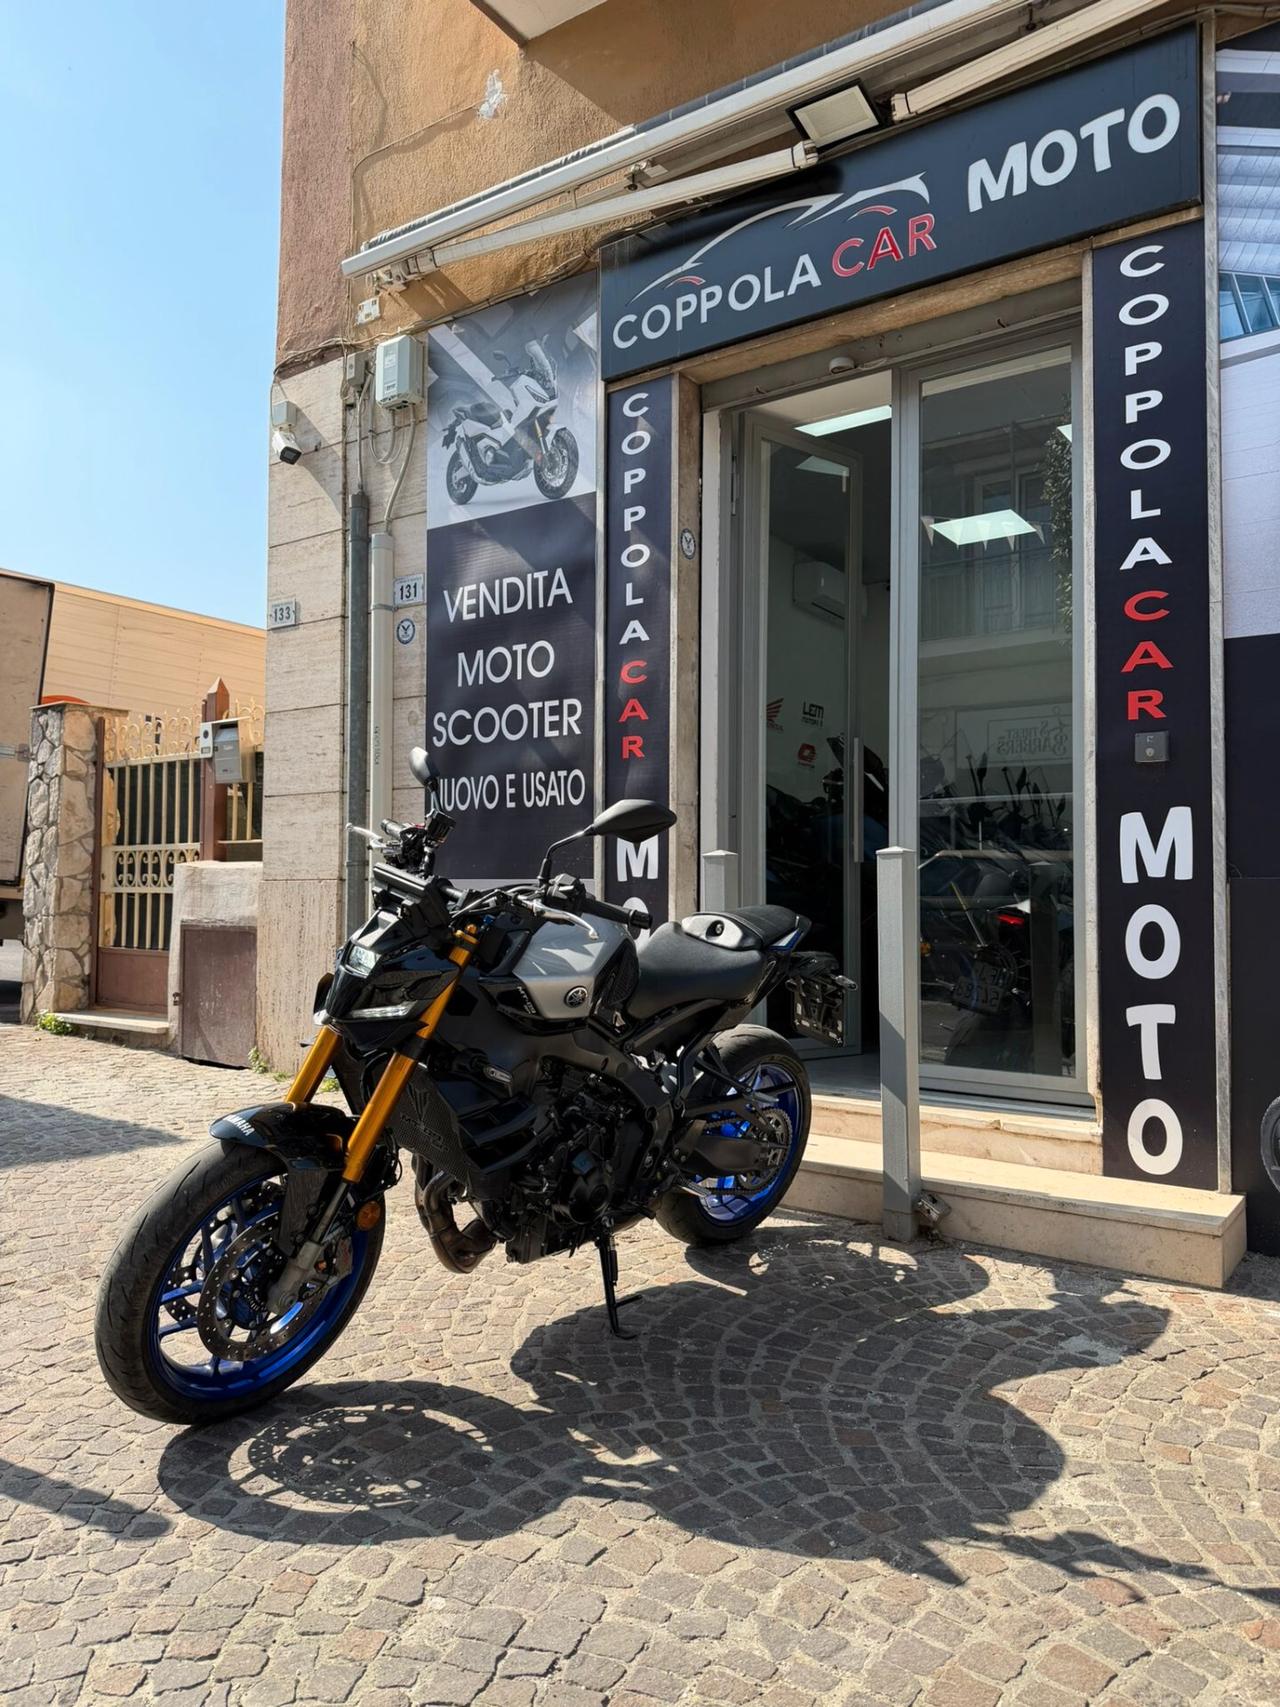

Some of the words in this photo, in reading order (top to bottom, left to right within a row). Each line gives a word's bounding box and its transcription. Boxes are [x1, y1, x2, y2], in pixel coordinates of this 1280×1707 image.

[968, 94, 1180, 213] MOTO
[612, 254, 822, 350] COPPOLA
[831, 212, 937, 278] CAR
[1118, 245, 1173, 571] COPPOLA
[619, 392, 651, 645] COPPOLA
[274, 606, 291, 623] 133
[400, 582, 417, 600] 131
[443, 567, 574, 623] VENDITA
[457, 640, 556, 688] MOTO
[1121, 590, 1174, 720] CAR
[432, 698, 583, 748] SCOOTER
[618, 660, 649, 760] CAR
[506, 774, 517, 809] E
[522, 768, 586, 809] USATO
[1119, 806, 1194, 1175] MOTO
